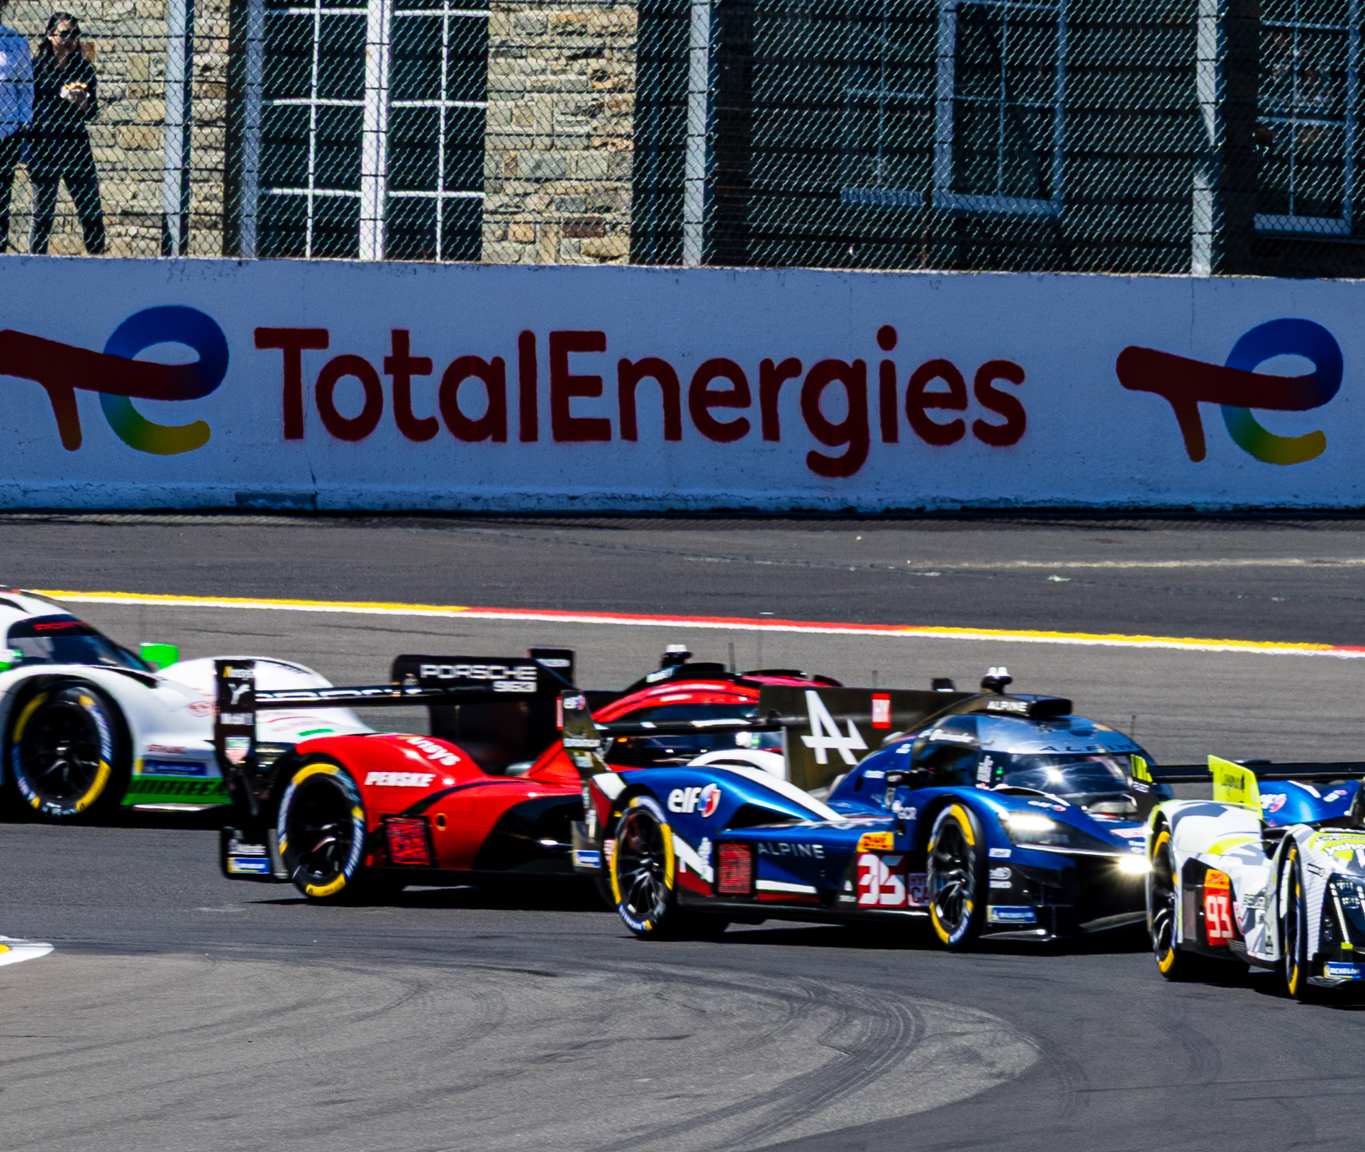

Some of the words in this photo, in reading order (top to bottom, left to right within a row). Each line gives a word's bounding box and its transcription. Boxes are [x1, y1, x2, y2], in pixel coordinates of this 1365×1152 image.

[255, 325, 1026, 478] TotalEnergies
[420, 664, 537, 680] PORSCHE
[493, 681, 537, 692] 963
[986, 700, 1027, 712] ALPINE
[364, 771, 436, 787] PENSKE
[667, 786, 703, 813] elf
[757, 841, 826, 860] ALPINE
[857, 854, 906, 905] 35
[1205, 895, 1235, 939] 93
